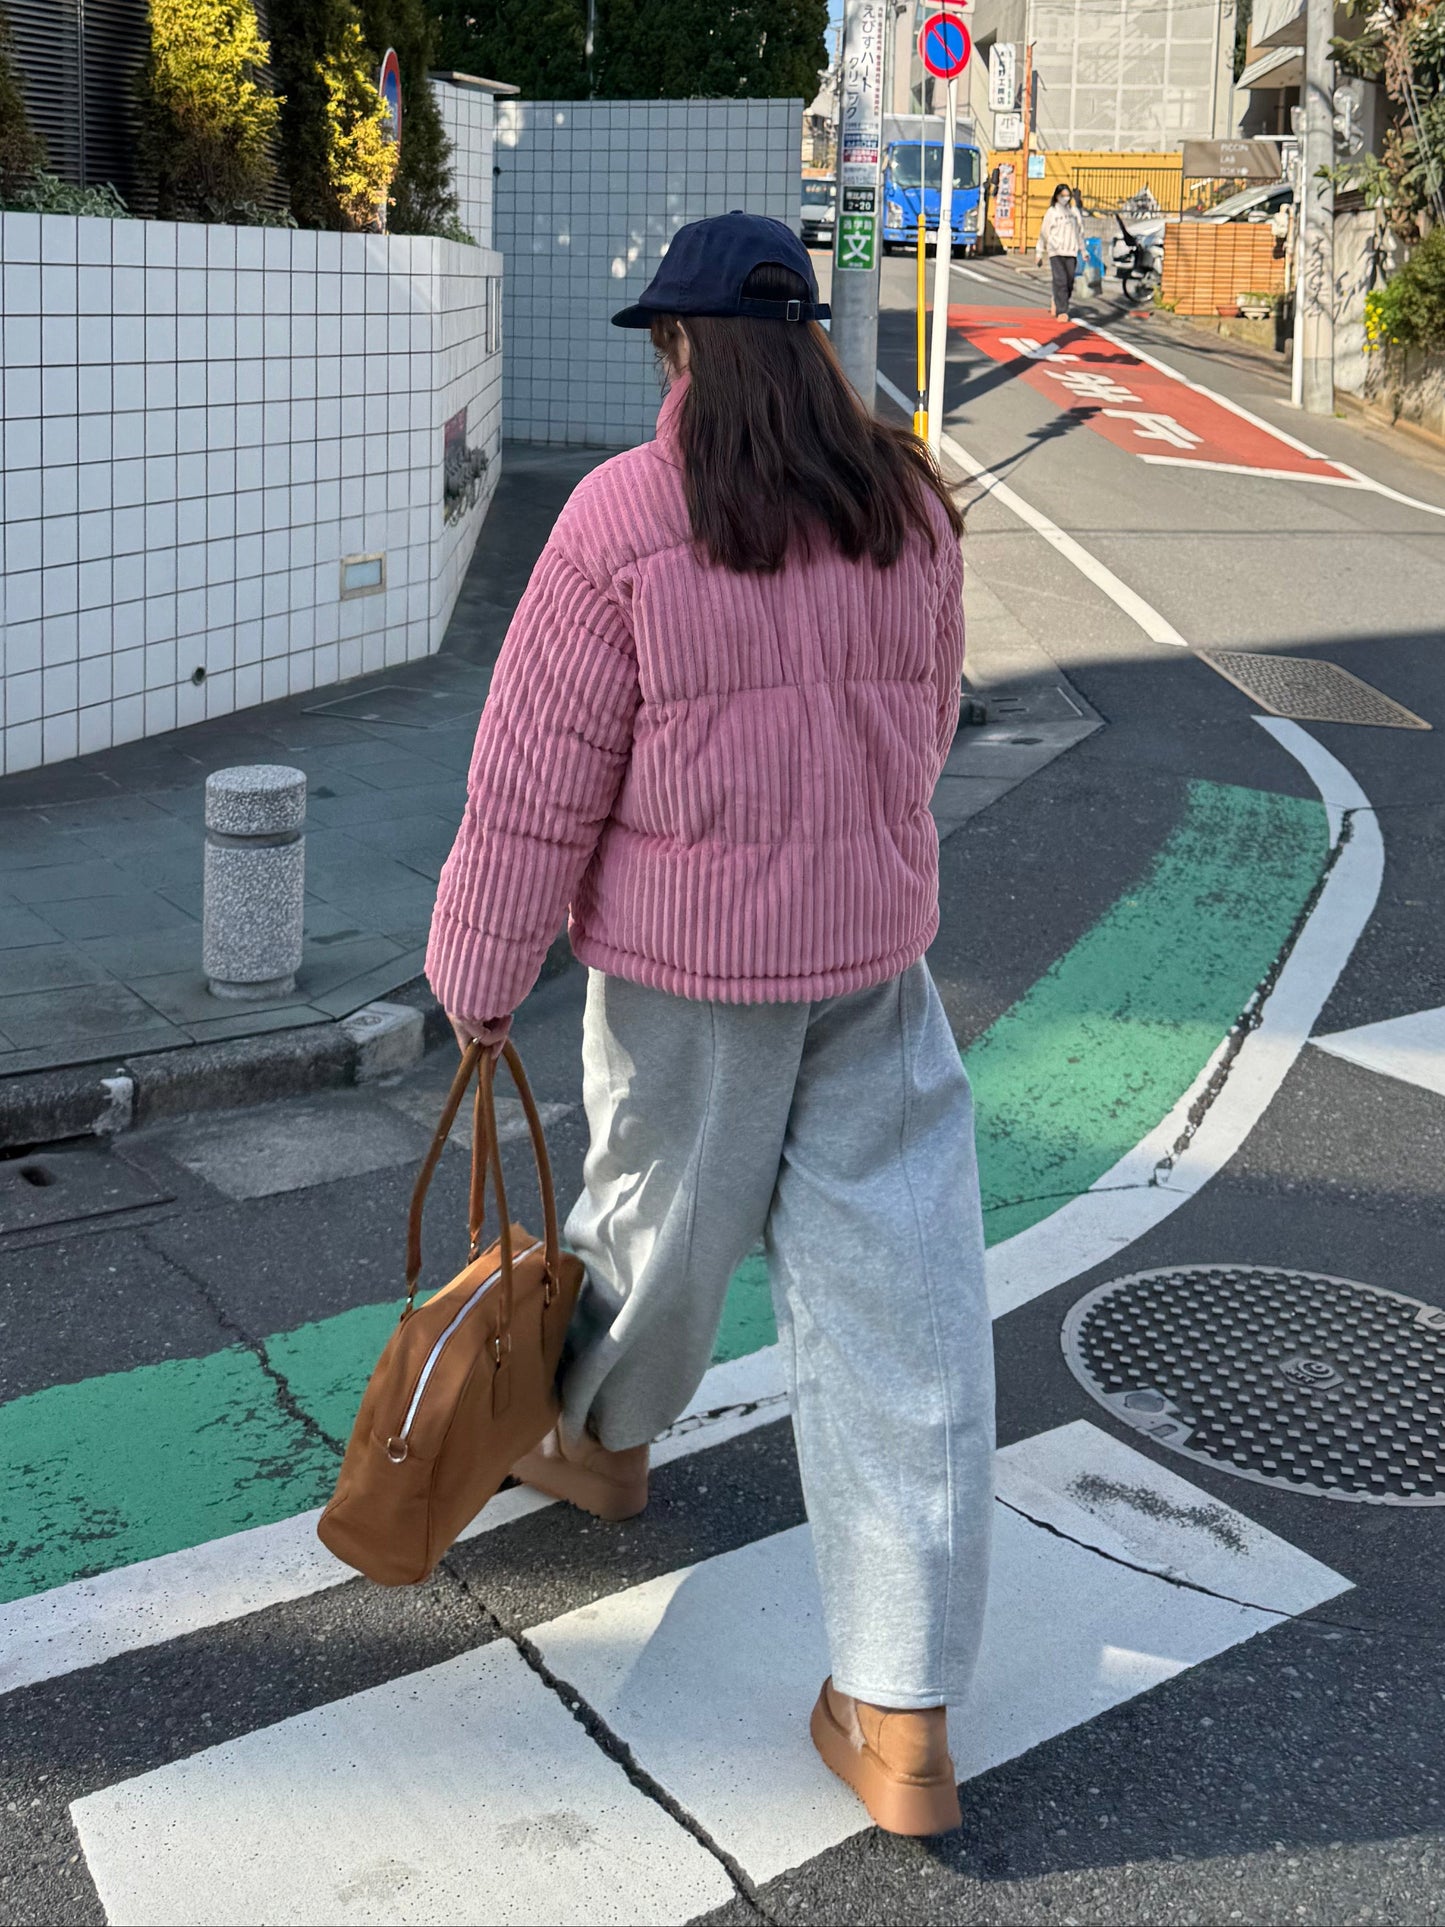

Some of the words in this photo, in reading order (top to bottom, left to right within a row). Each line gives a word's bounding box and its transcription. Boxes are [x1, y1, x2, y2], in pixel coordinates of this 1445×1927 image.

[861, 4, 875, 93] えびすハート
[846, 57, 859, 119] クリニック
[1220, 155, 1236, 164] LAB
[842, 230, 871, 262] 文
